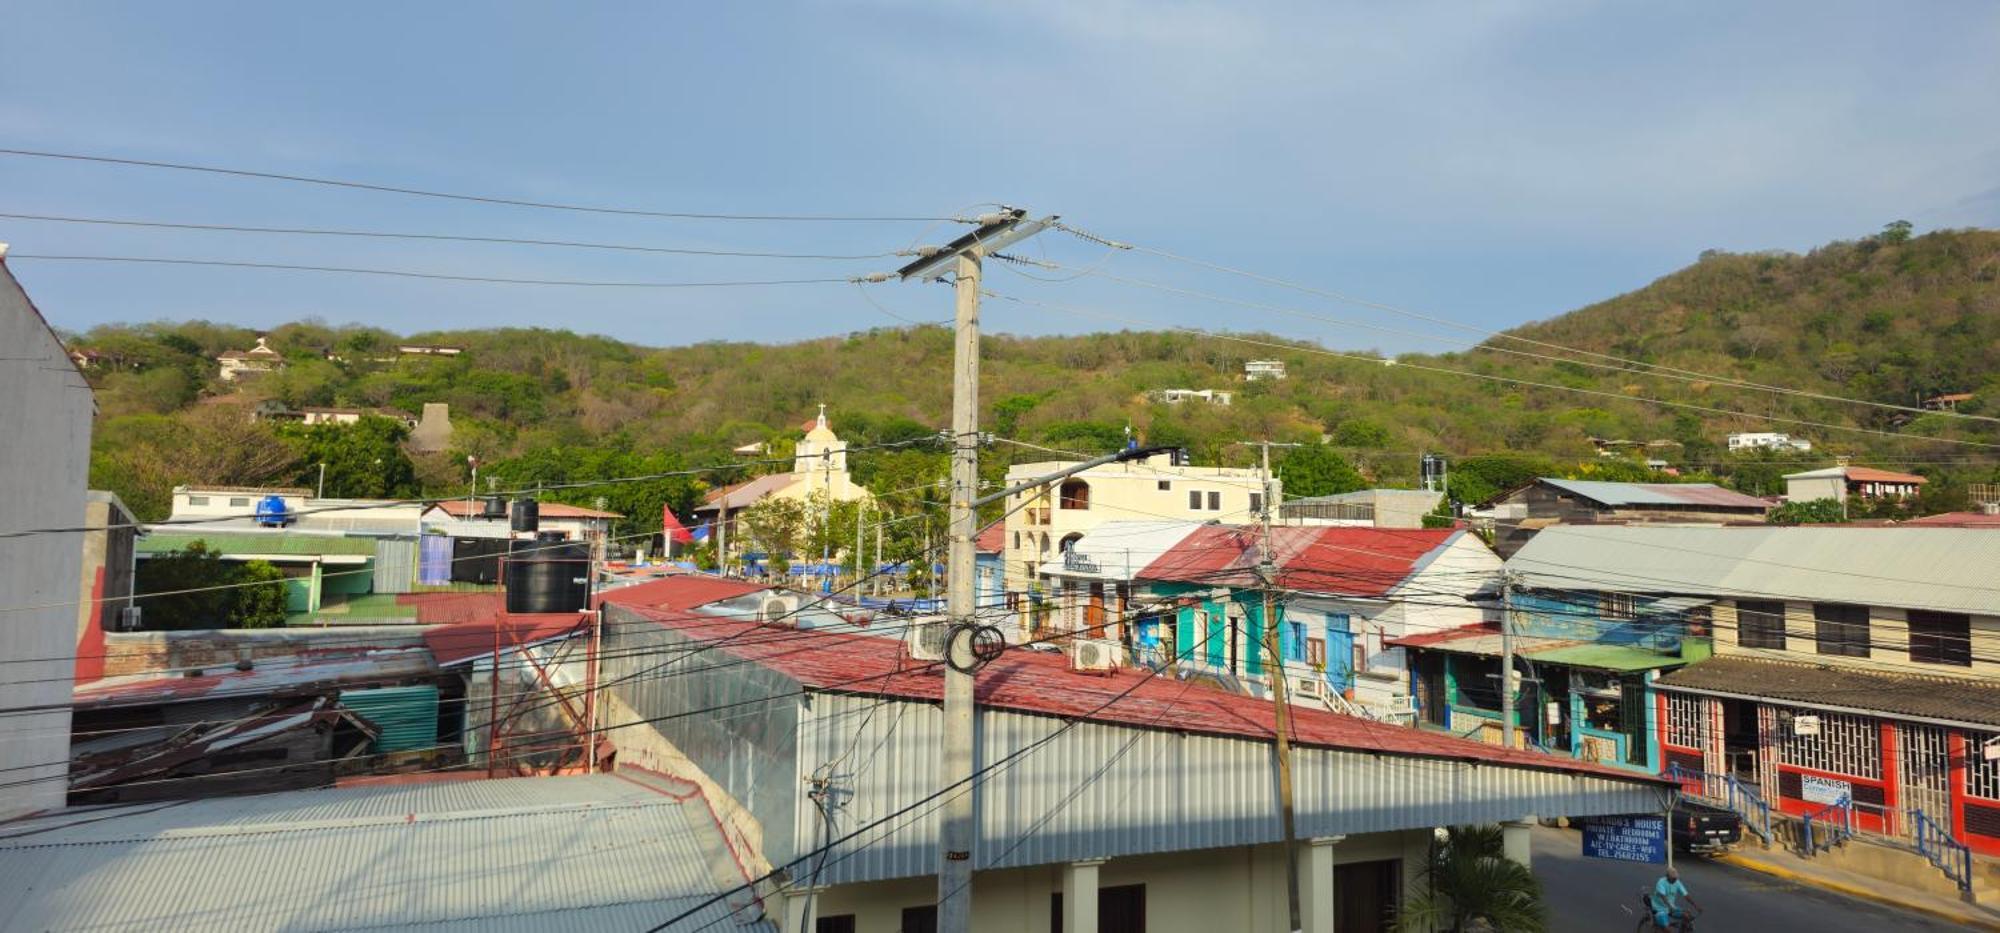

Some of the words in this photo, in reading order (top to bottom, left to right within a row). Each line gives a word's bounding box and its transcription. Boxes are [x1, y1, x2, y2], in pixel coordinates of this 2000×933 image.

[1803, 775, 1850, 790] SPANISH
[1586, 824, 1614, 833] PRIVATE
[1621, 827, 1660, 839] BEDROOMS
[1634, 819, 1663, 830] HOUSE
